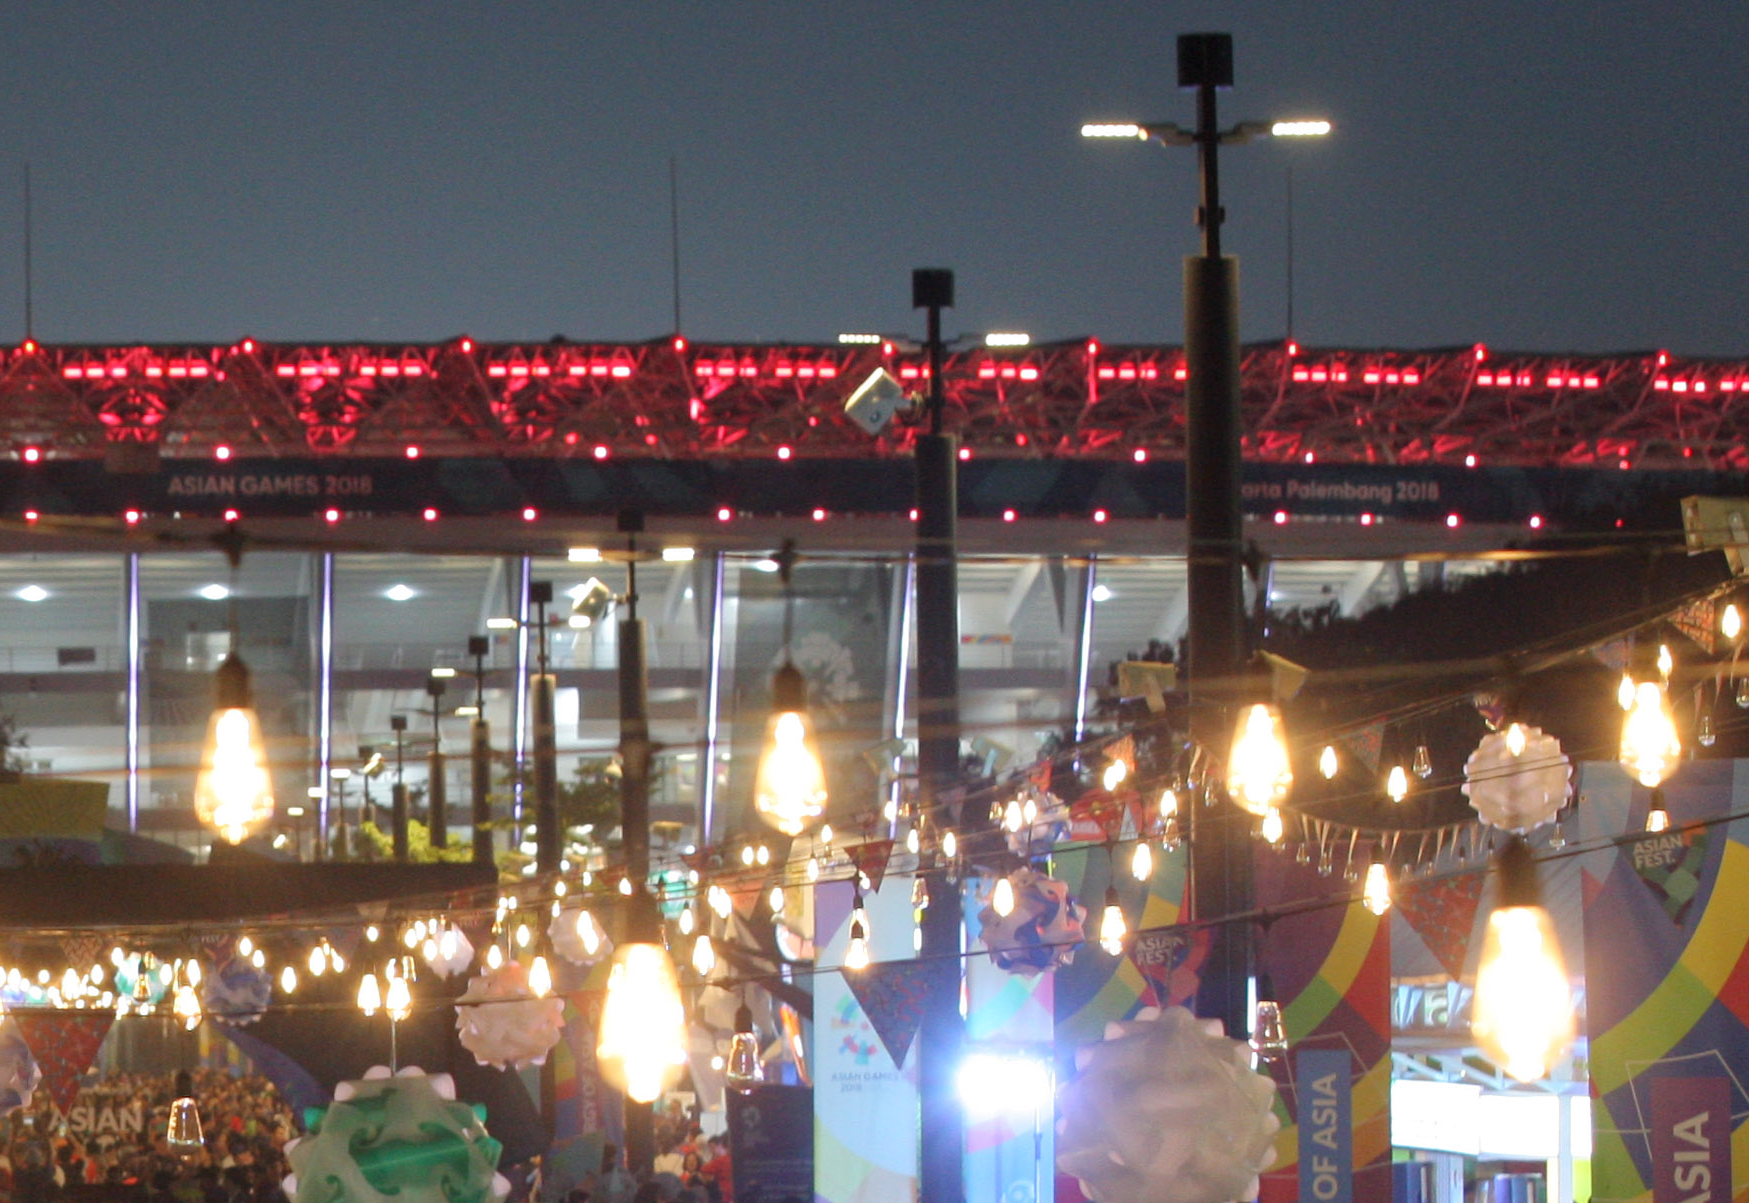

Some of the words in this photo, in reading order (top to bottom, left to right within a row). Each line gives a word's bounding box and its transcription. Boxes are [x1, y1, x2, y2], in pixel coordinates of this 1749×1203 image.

[168, 475, 235, 495] ASIAN
[240, 475, 319, 495] GAMES
[325, 475, 373, 495] 2018
[1287, 479, 1392, 503] Palembang
[1398, 481, 1439, 500] 2018
[1633, 834, 1683, 855] ASIAN
[1311, 1073, 1338, 1149] ASIA
[1312, 1155, 1338, 1200] OF
